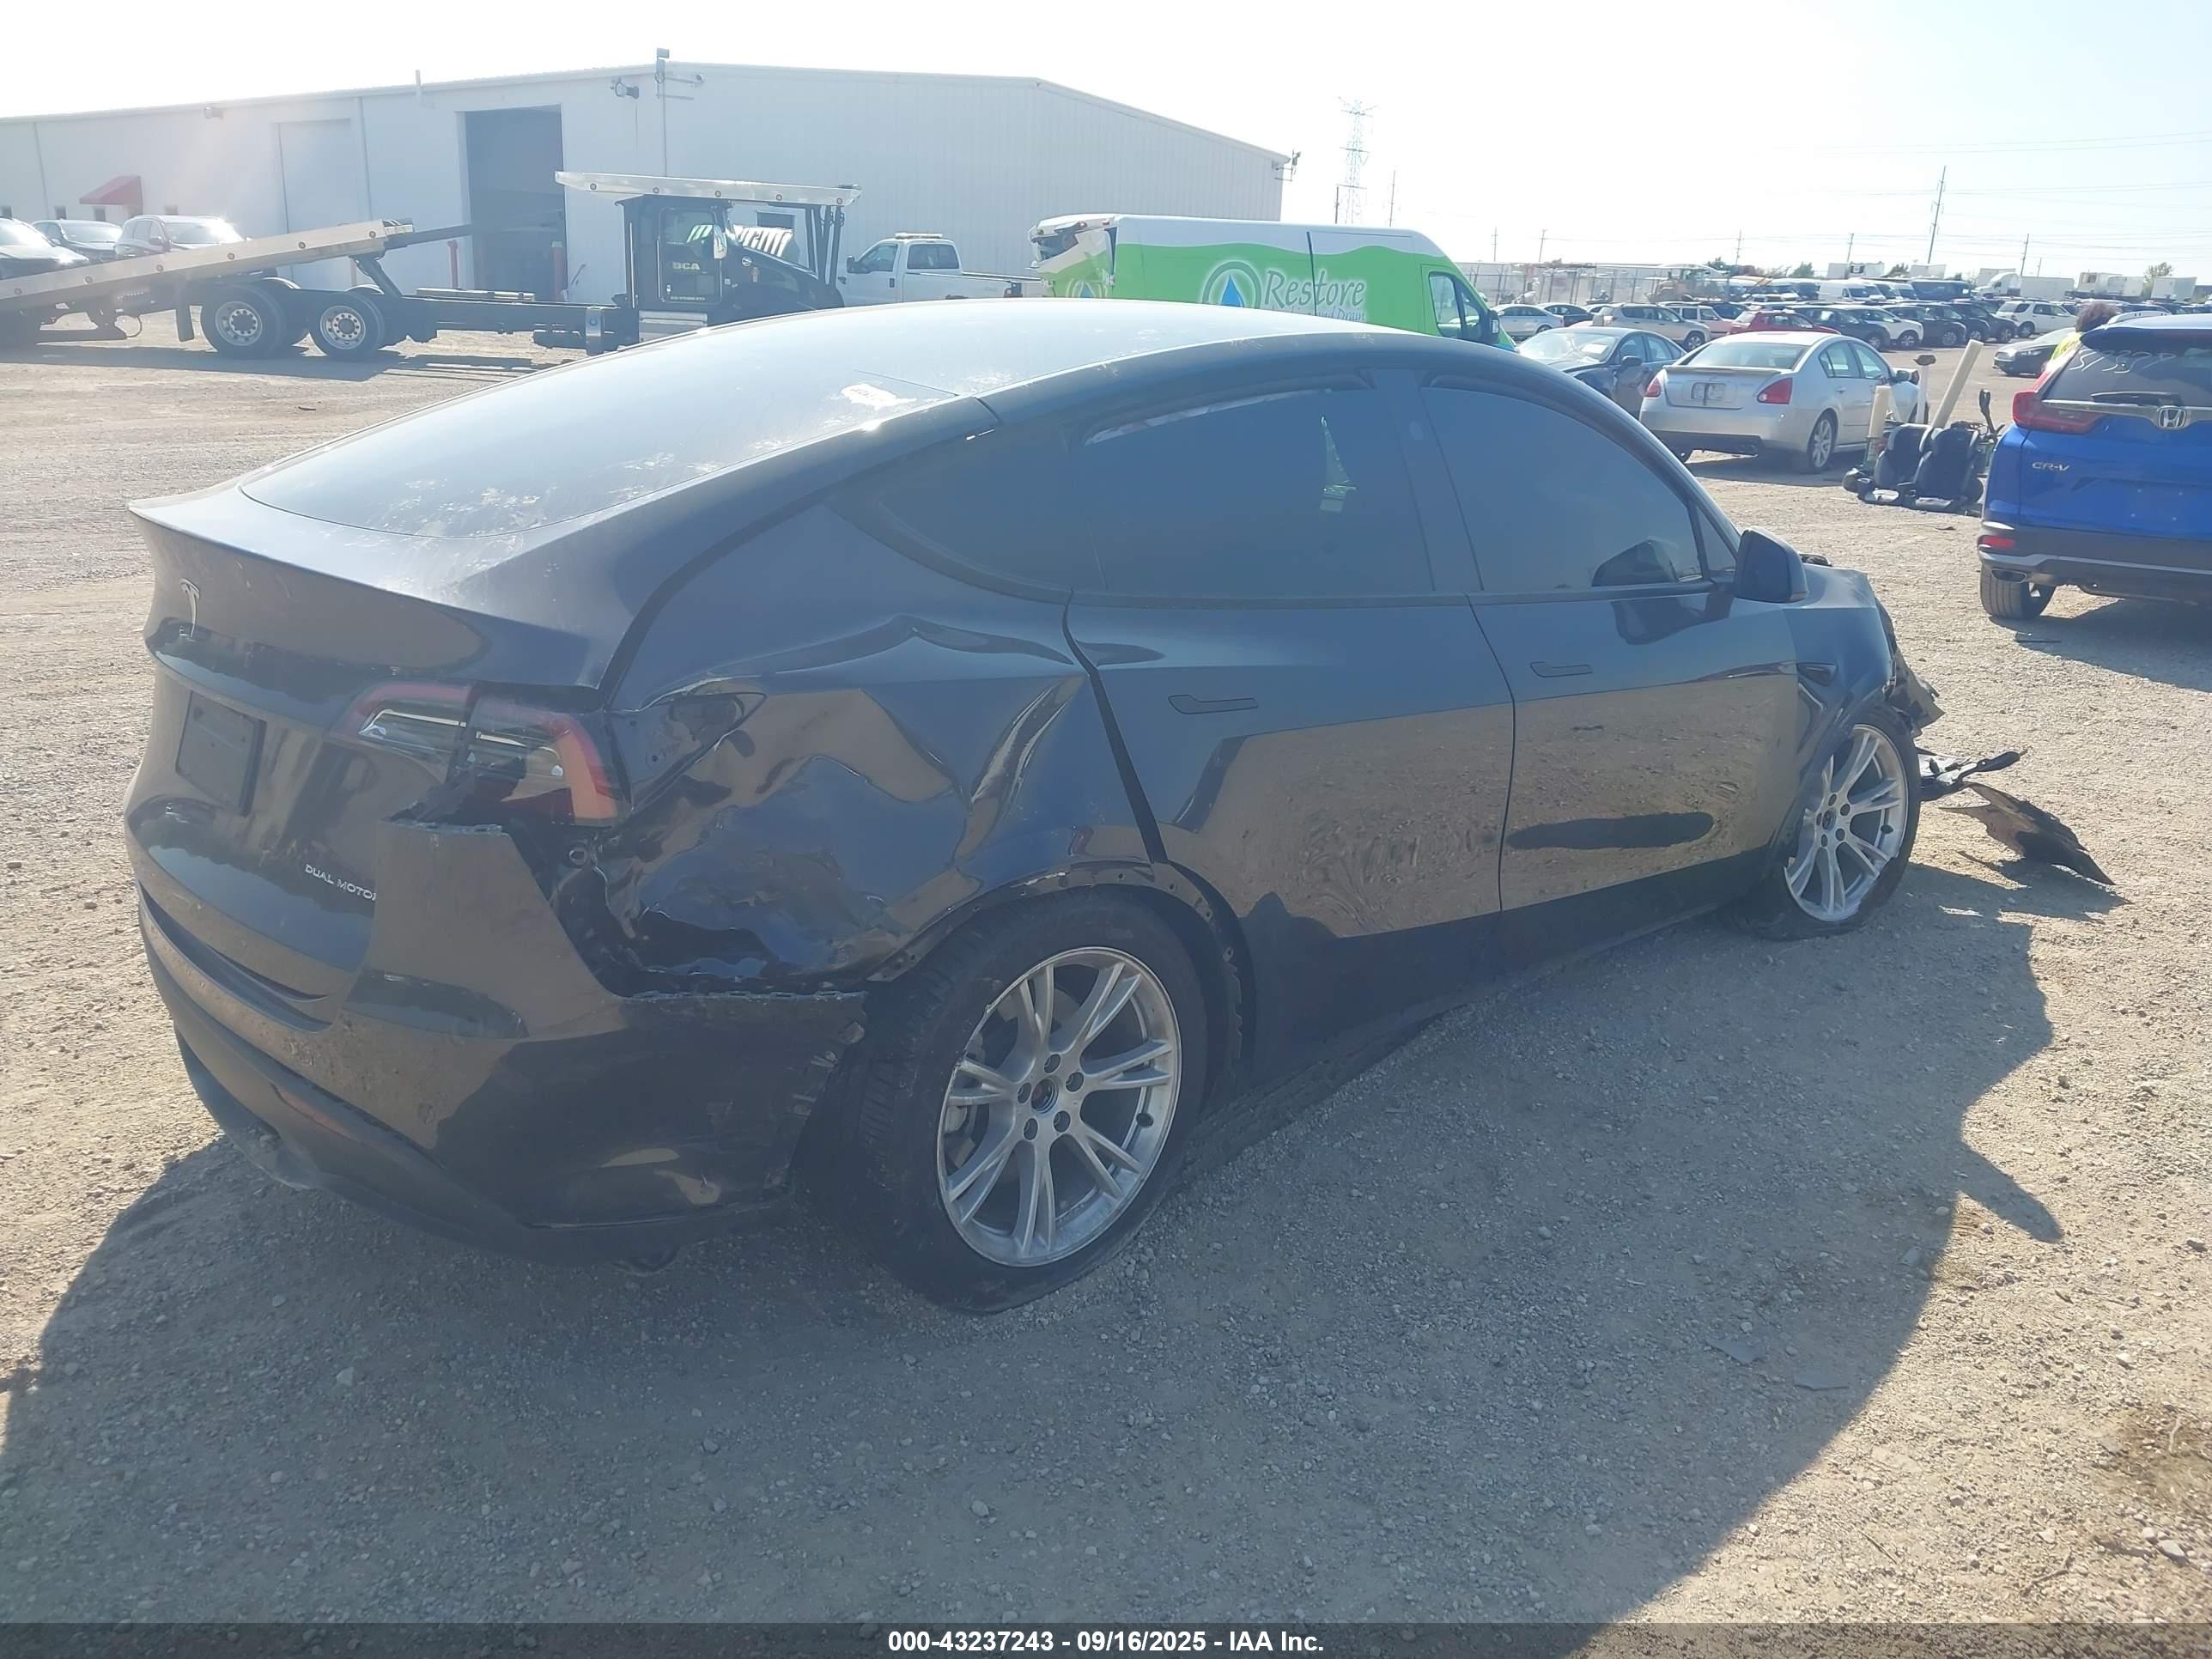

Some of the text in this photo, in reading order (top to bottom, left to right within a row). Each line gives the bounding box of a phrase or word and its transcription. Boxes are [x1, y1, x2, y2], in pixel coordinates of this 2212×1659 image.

[1264, 269, 1365, 308] Restore
[2032, 461, 2070, 471] CR-V
[305, 864, 334, 884] DUAL
